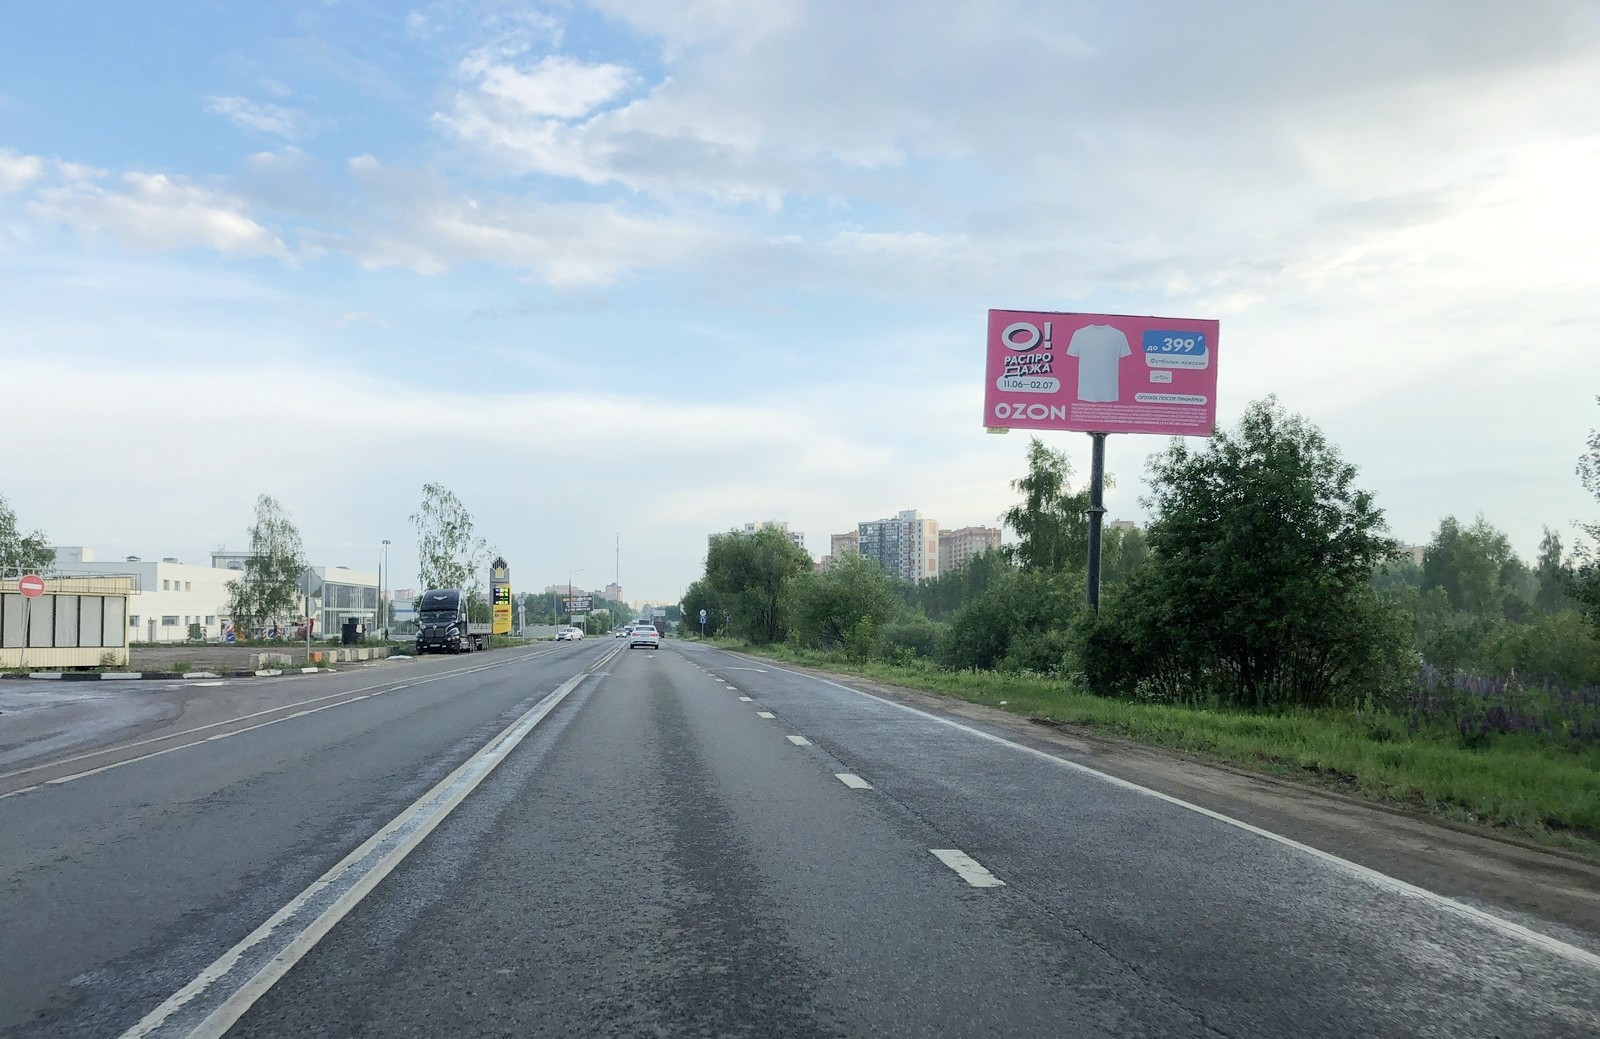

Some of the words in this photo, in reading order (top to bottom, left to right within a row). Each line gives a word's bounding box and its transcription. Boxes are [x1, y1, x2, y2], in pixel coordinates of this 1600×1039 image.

[1147, 345, 1158, 353] до
[1161, 337, 1194, 352] 399
[1004, 353, 1053, 367] РАСПРО
[1003, 364, 1052, 378] ДАЖА
[994, 402, 1066, 421] OZON
